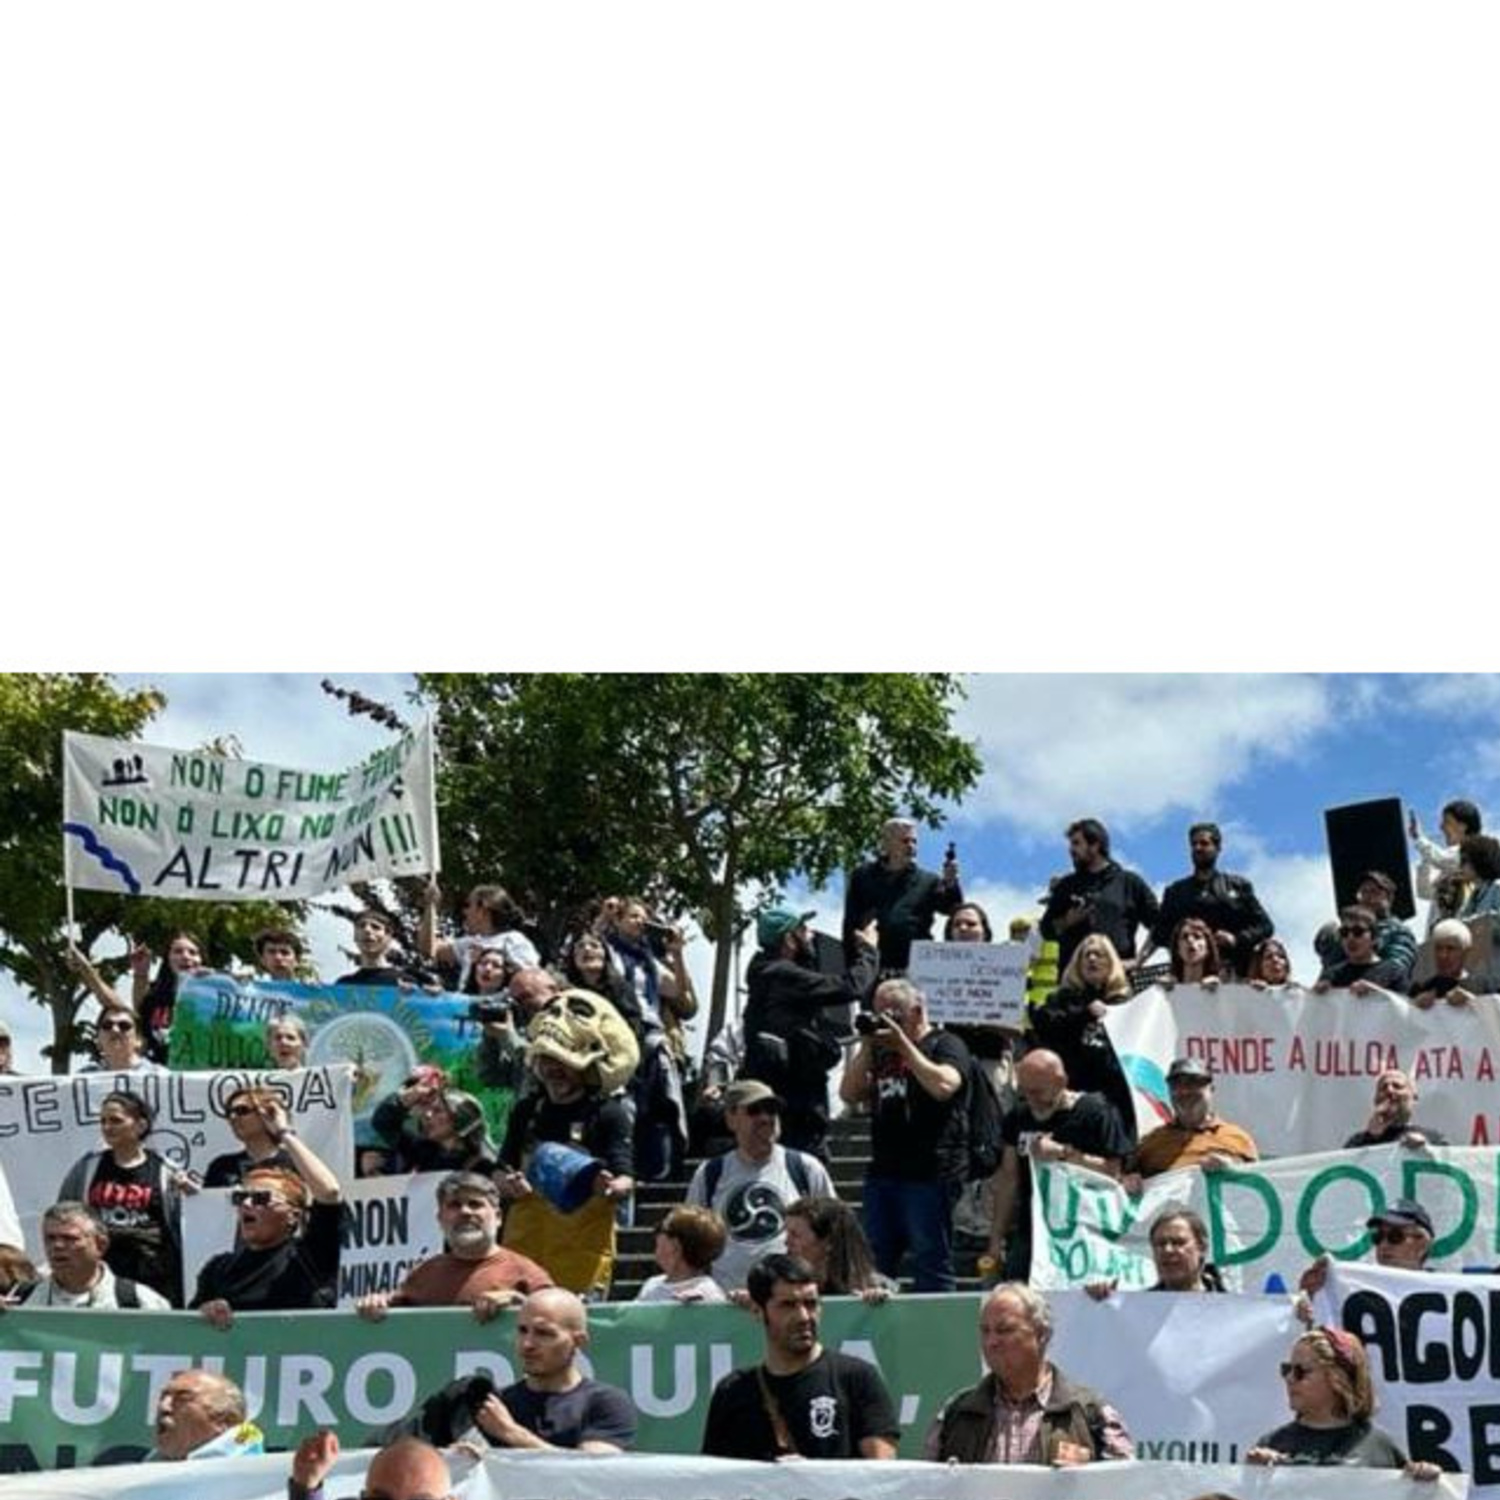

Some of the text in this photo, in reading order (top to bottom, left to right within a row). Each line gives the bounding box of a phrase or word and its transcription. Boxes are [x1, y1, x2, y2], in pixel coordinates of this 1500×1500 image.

[170, 754, 224, 795] NON
[98, 797, 160, 832] NON
[210, 808, 285, 842] LIXO
[153, 844, 303, 891] ALTRI
[1288, 1037, 1307, 1071] A
[1314, 1039, 1402, 1077] ULLOA
[1415, 1046, 1463, 1081] ATA
[1475, 1047, 1495, 1082] A
[340, 1197, 409, 1250] NON
